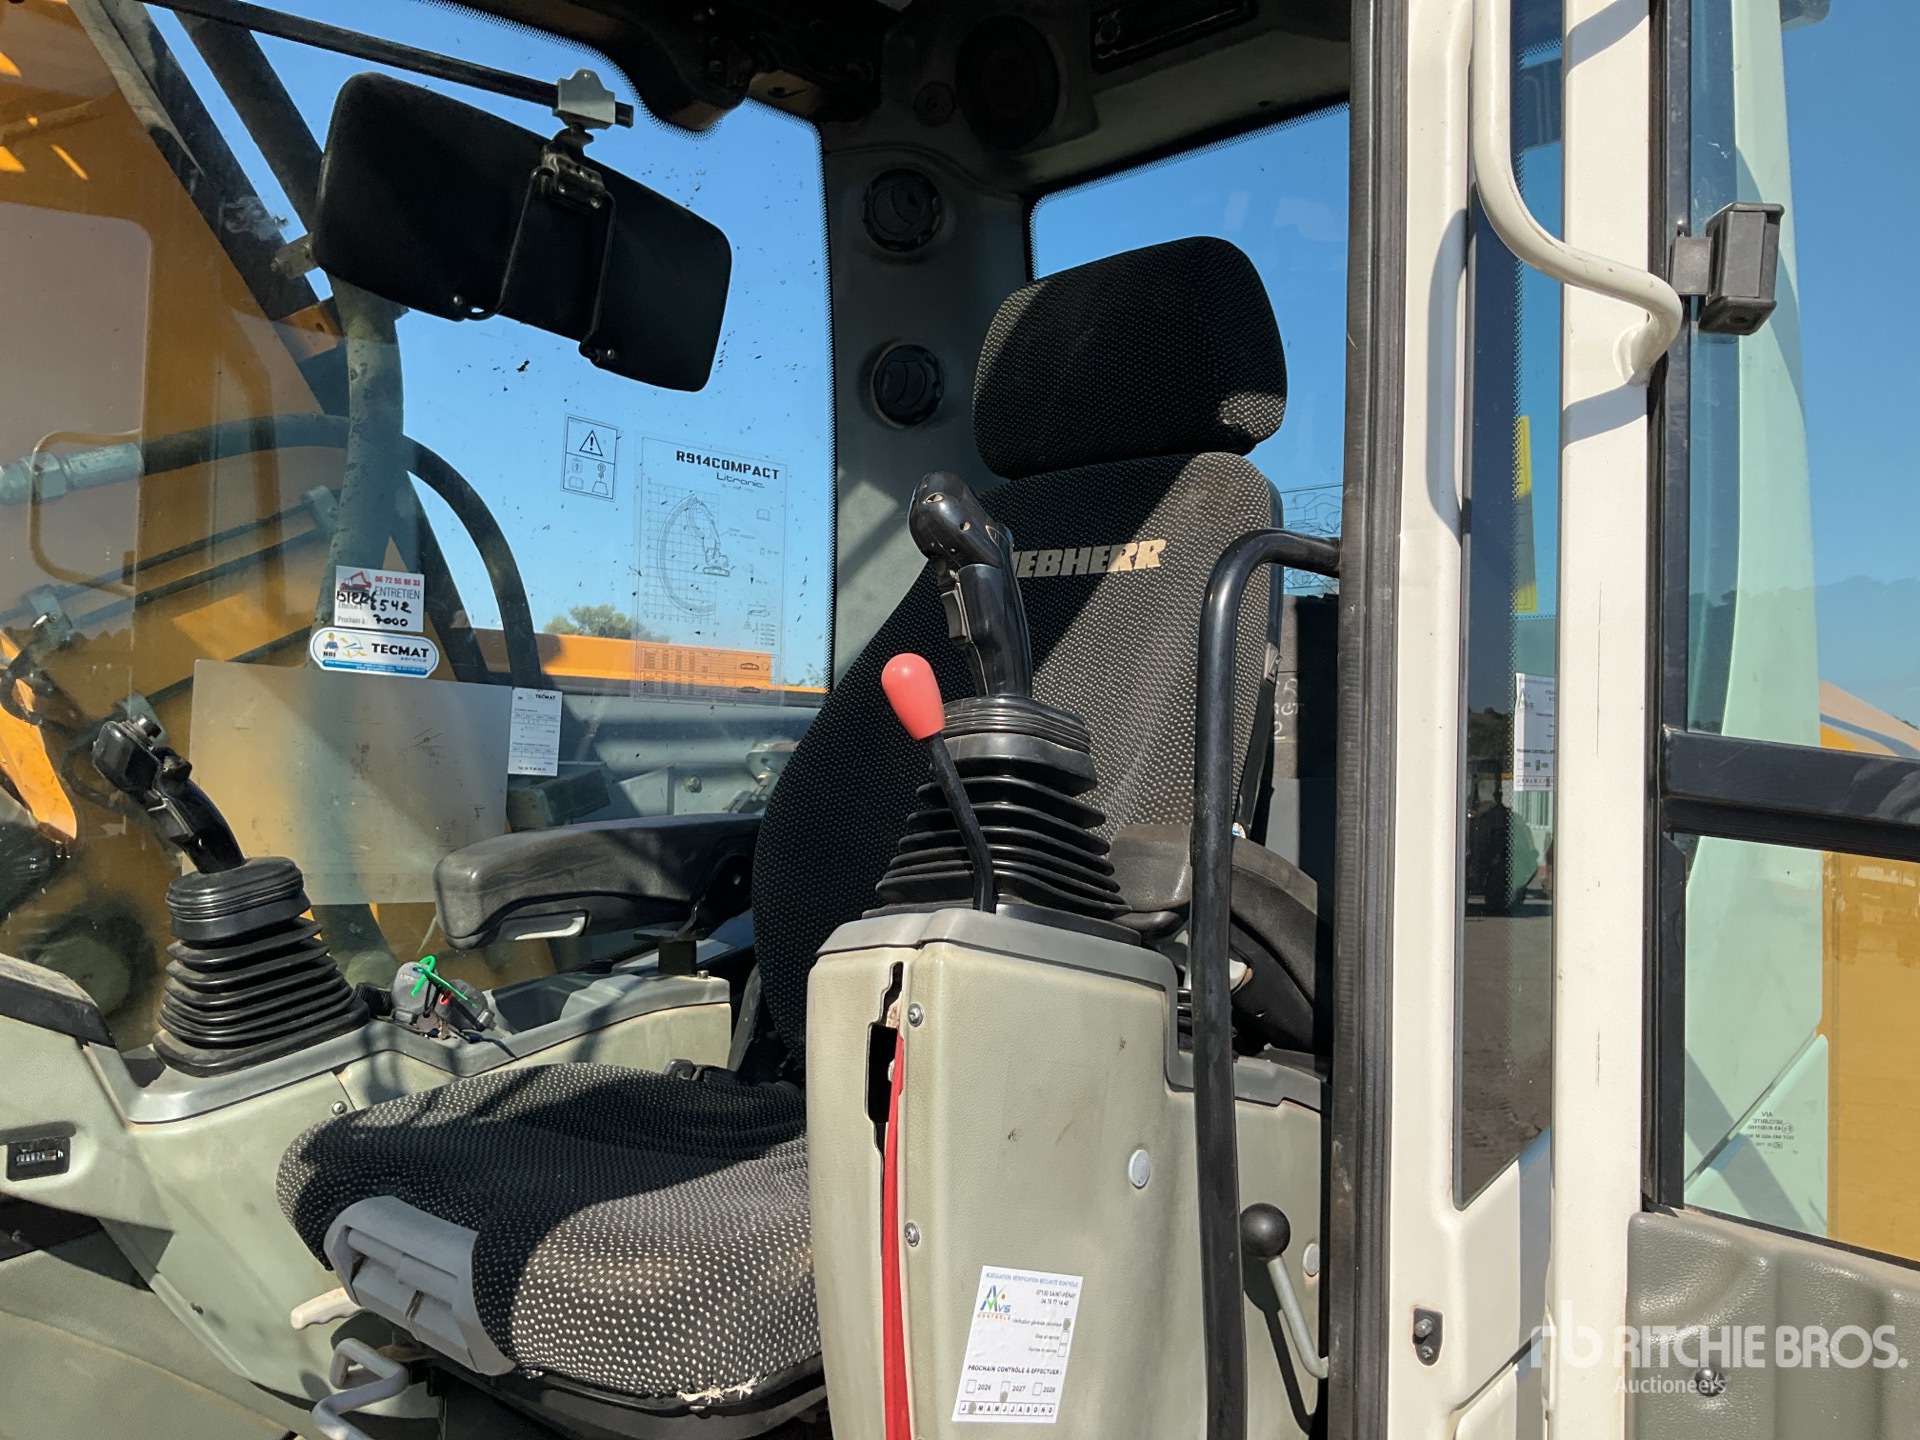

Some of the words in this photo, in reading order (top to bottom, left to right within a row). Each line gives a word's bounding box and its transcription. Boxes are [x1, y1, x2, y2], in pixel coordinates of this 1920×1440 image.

[676, 450, 780, 480] R914COMPACT
[716, 472, 764, 488] Litronic
[1012, 538, 1166, 578] IEBHERR
[374, 586, 420, 600] ENTRETIEN
[371, 643, 429, 658] TECMAT
[967, 1364, 995, 1372] PROCHAIN
[997, 1366, 1024, 1374] CONTRÔLE
